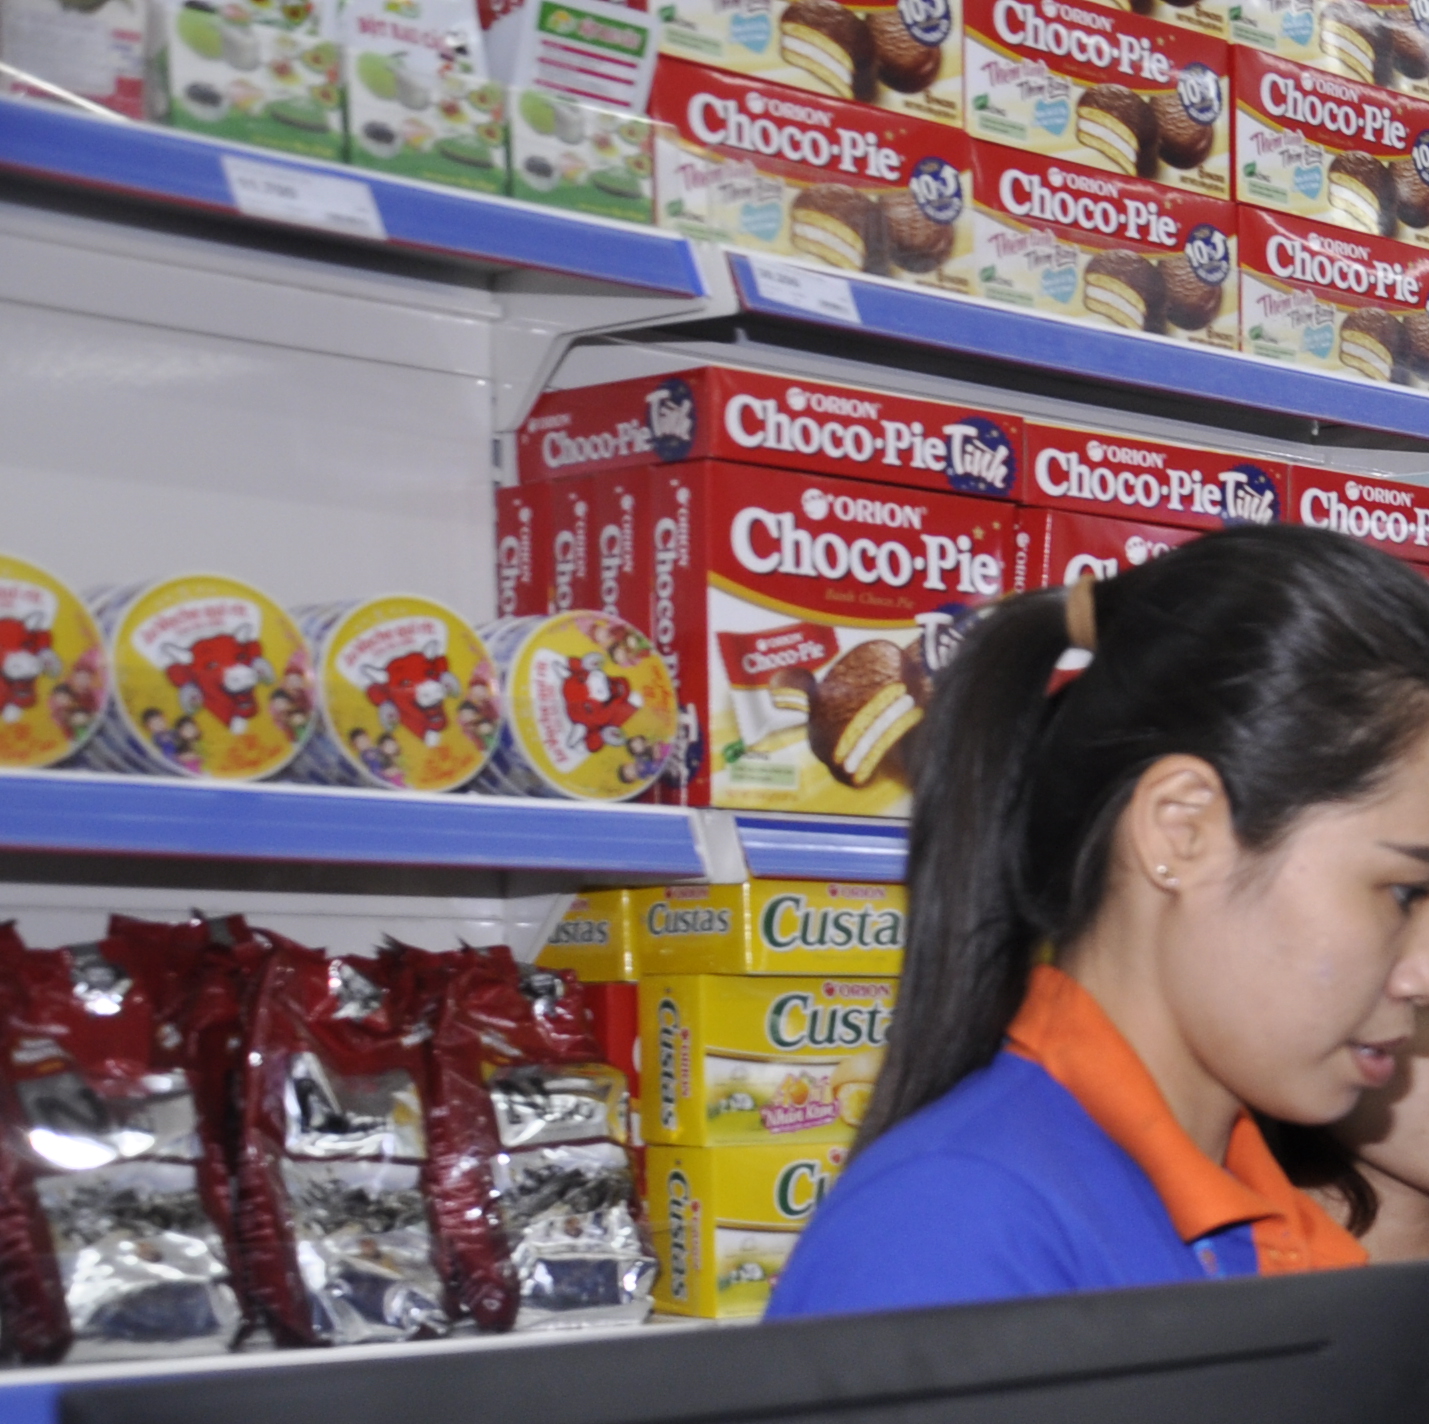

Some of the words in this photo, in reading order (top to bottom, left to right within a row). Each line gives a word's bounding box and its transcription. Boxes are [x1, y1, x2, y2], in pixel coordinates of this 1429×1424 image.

[1316, 79, 1359, 103] ORION
[1066, 173, 1120, 199] ORION
[810, 391, 880, 419] ORION
[1107, 446, 1166, 469] ORION
[1363, 485, 1414, 508] ORION
[834, 494, 927, 530] ORION
[548, 918, 611, 946] ustas
[646, 901, 730, 936] Custas
[760, 894, 904, 949] Custa
[768, 992, 893, 1050] Cust
